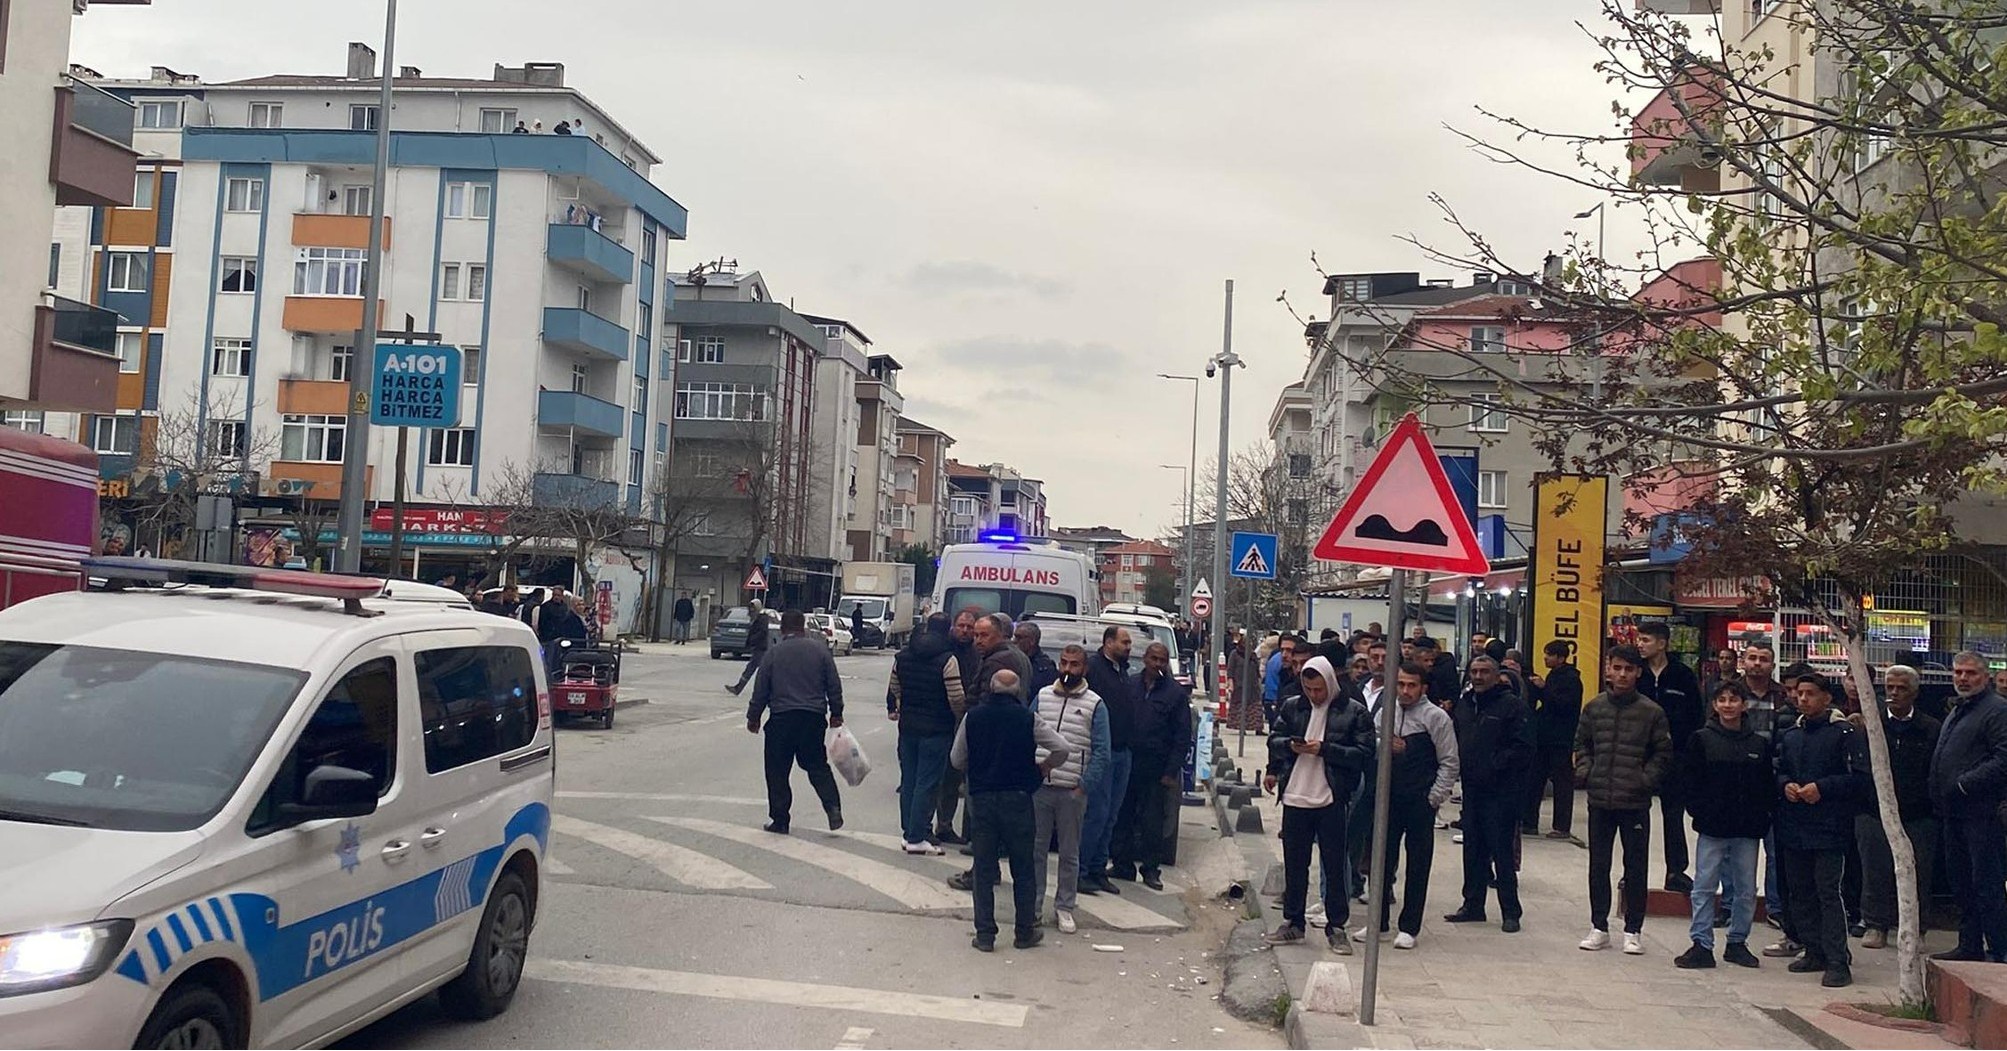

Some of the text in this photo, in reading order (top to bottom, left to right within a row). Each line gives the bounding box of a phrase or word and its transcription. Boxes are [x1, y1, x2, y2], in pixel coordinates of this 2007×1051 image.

[382, 374, 444, 390] HARCA
[381, 389, 443, 405] HARCA
[437, 511, 464, 522] HAN
[960, 566, 1060, 586] AMBULANS
[1550, 538, 1581, 603] BÜFE
[304, 899, 386, 978] POLİS
